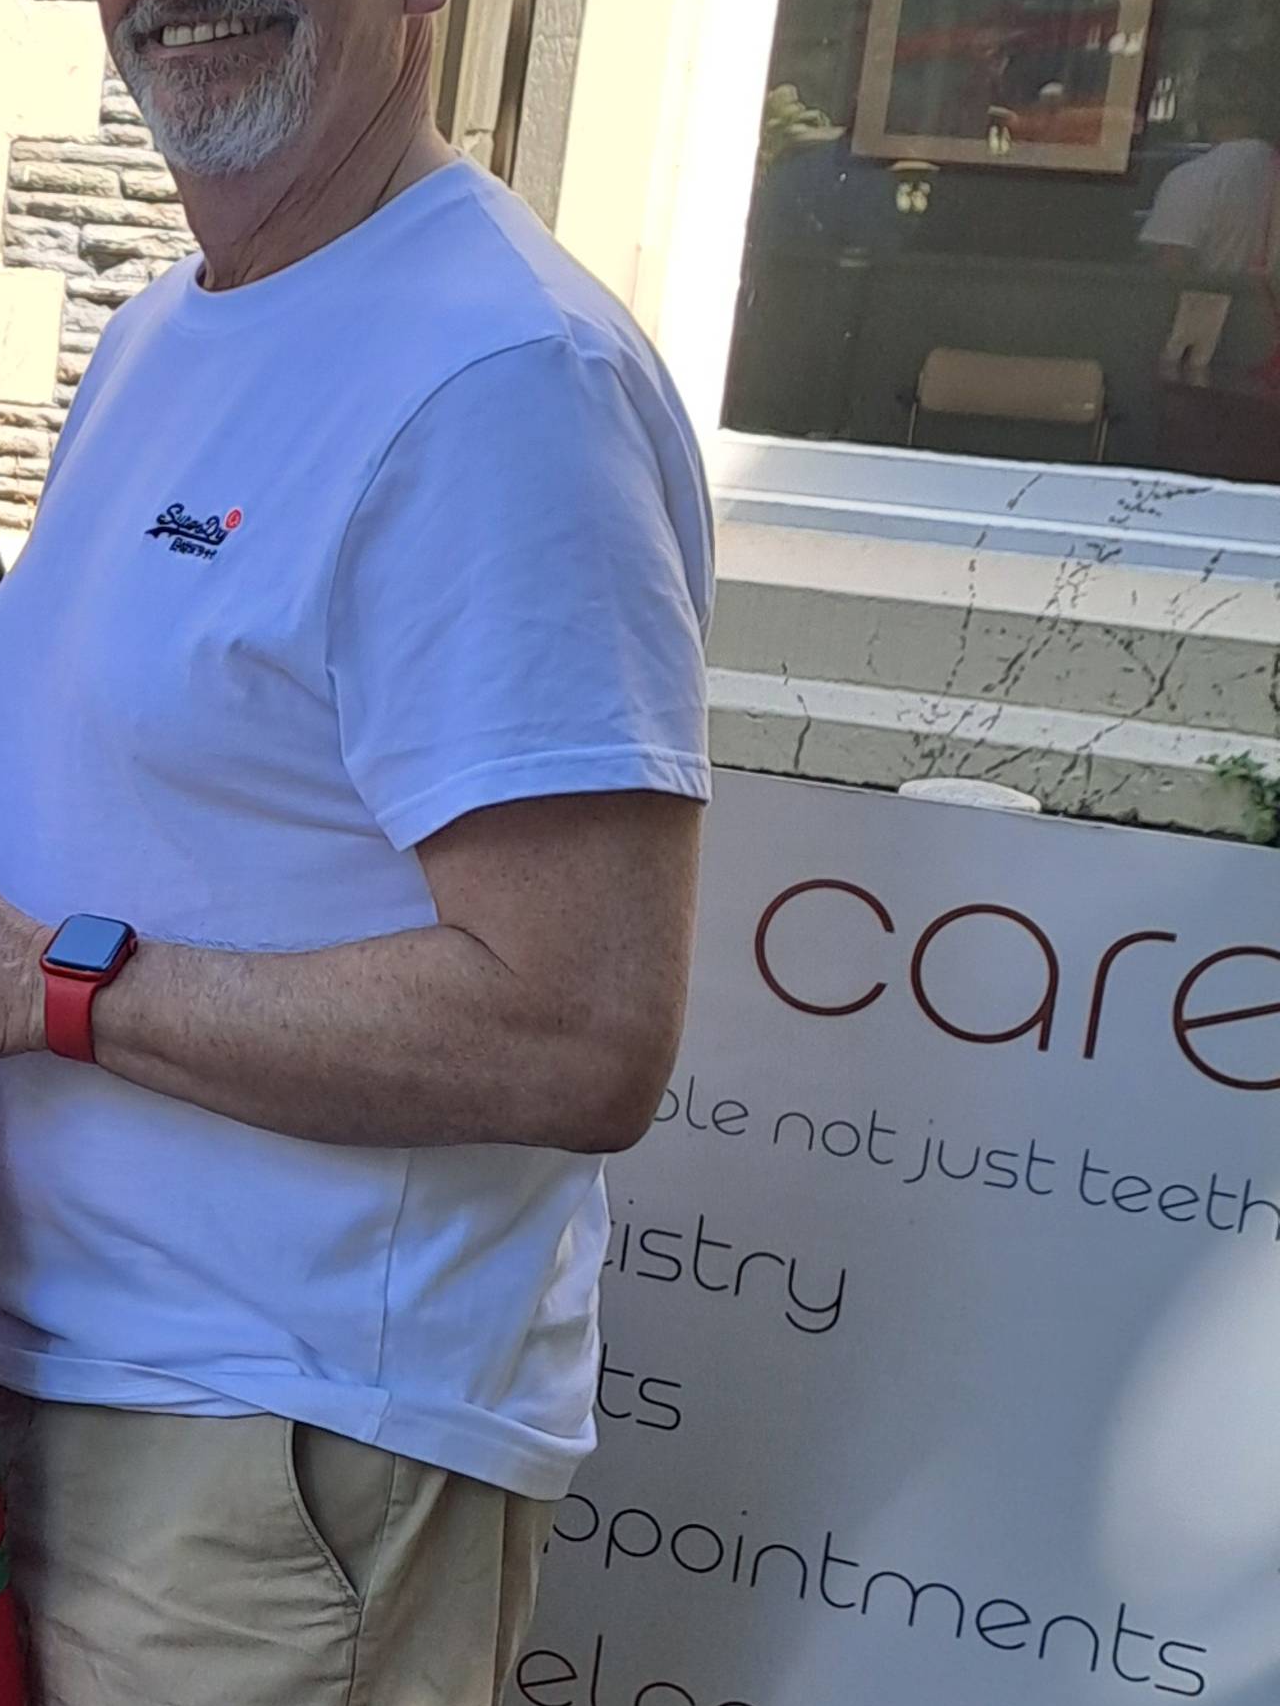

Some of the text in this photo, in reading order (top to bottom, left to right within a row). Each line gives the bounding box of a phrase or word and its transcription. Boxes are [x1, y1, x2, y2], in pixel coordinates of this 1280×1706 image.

[753, 878, 1280, 1091] care
[772, 1109, 897, 1165] not
[902, 1118, 1057, 1198] just
[1078, 1148, 1280, 1242] teeth
[604, 1199, 846, 1334] istry
